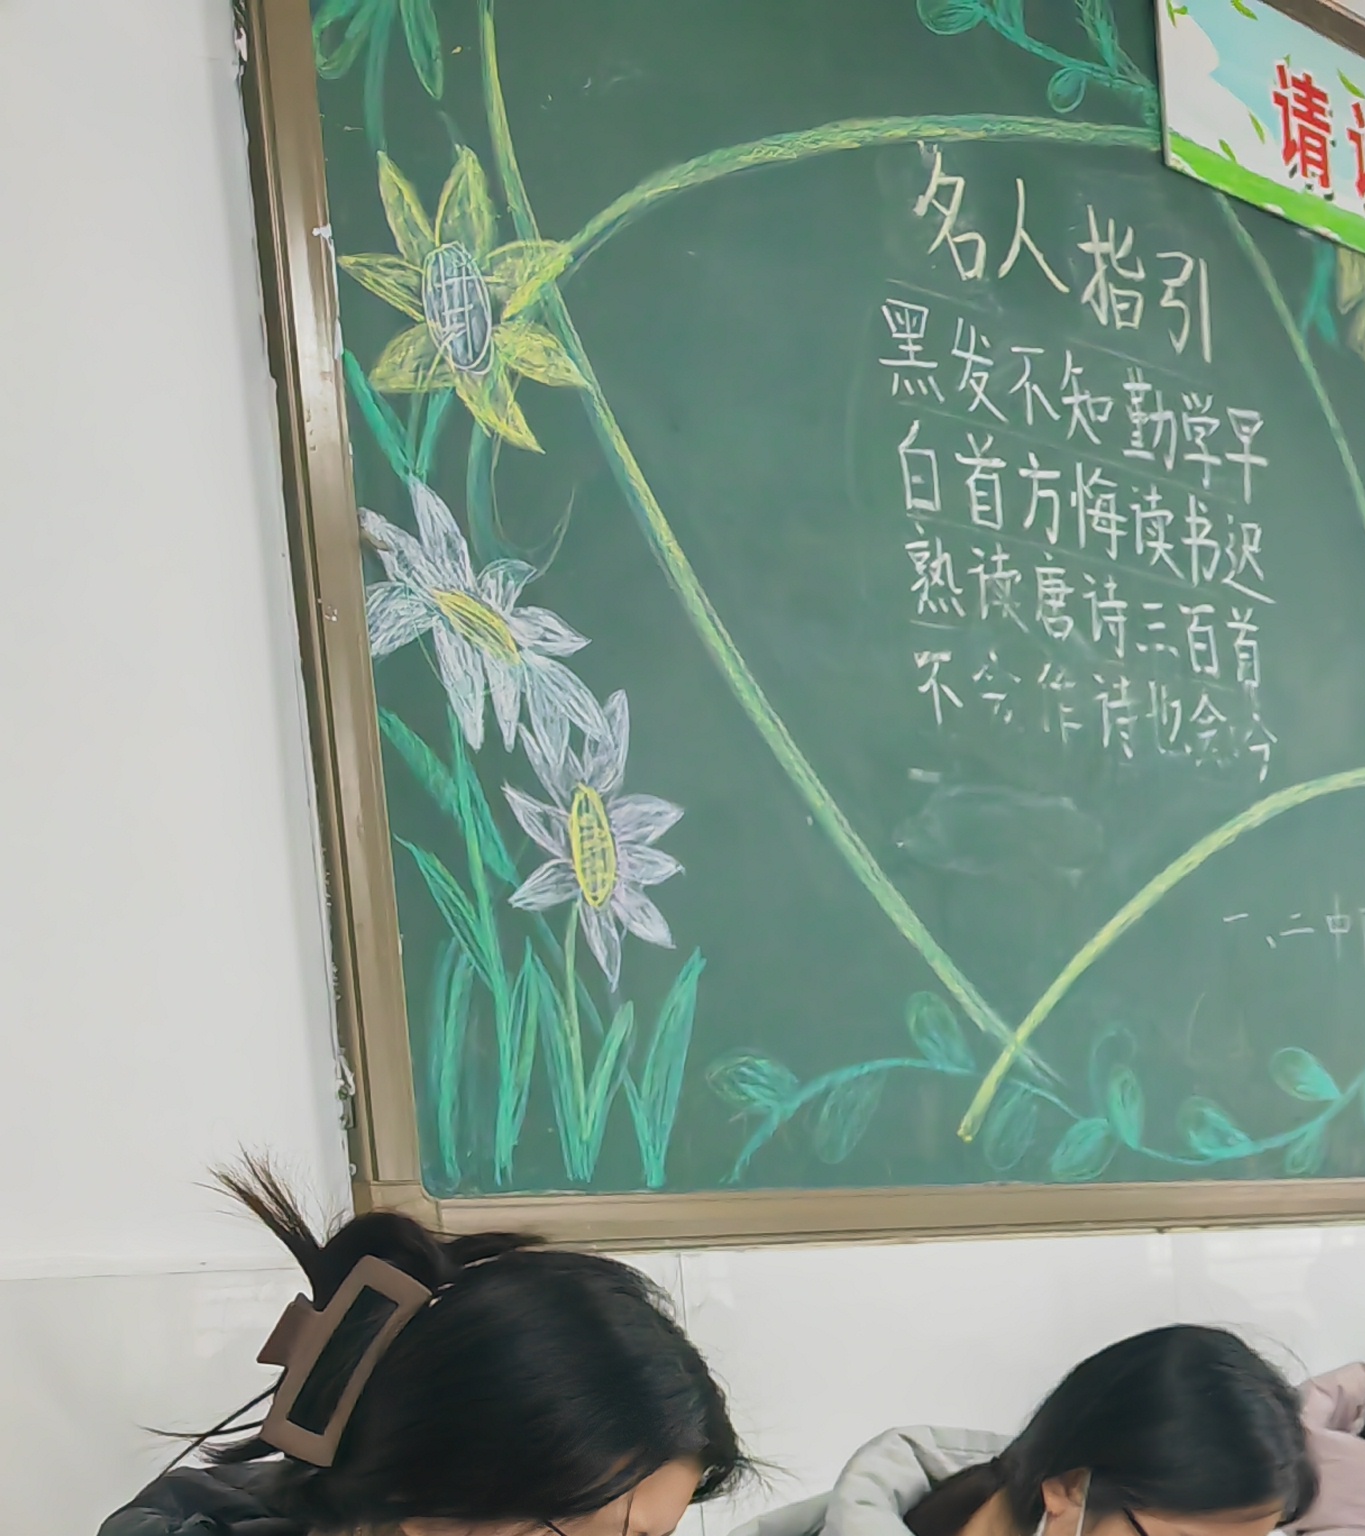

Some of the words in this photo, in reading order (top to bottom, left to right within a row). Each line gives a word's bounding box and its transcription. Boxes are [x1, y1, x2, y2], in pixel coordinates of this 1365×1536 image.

[913, 149, 1212, 362] 名人指引
[879, 298, 1270, 504] 黑发不知勤学早
[897, 419, 1276, 604] 白首方悔读书迟
[905, 523, 1262, 687] 熟读唐诗三百首
